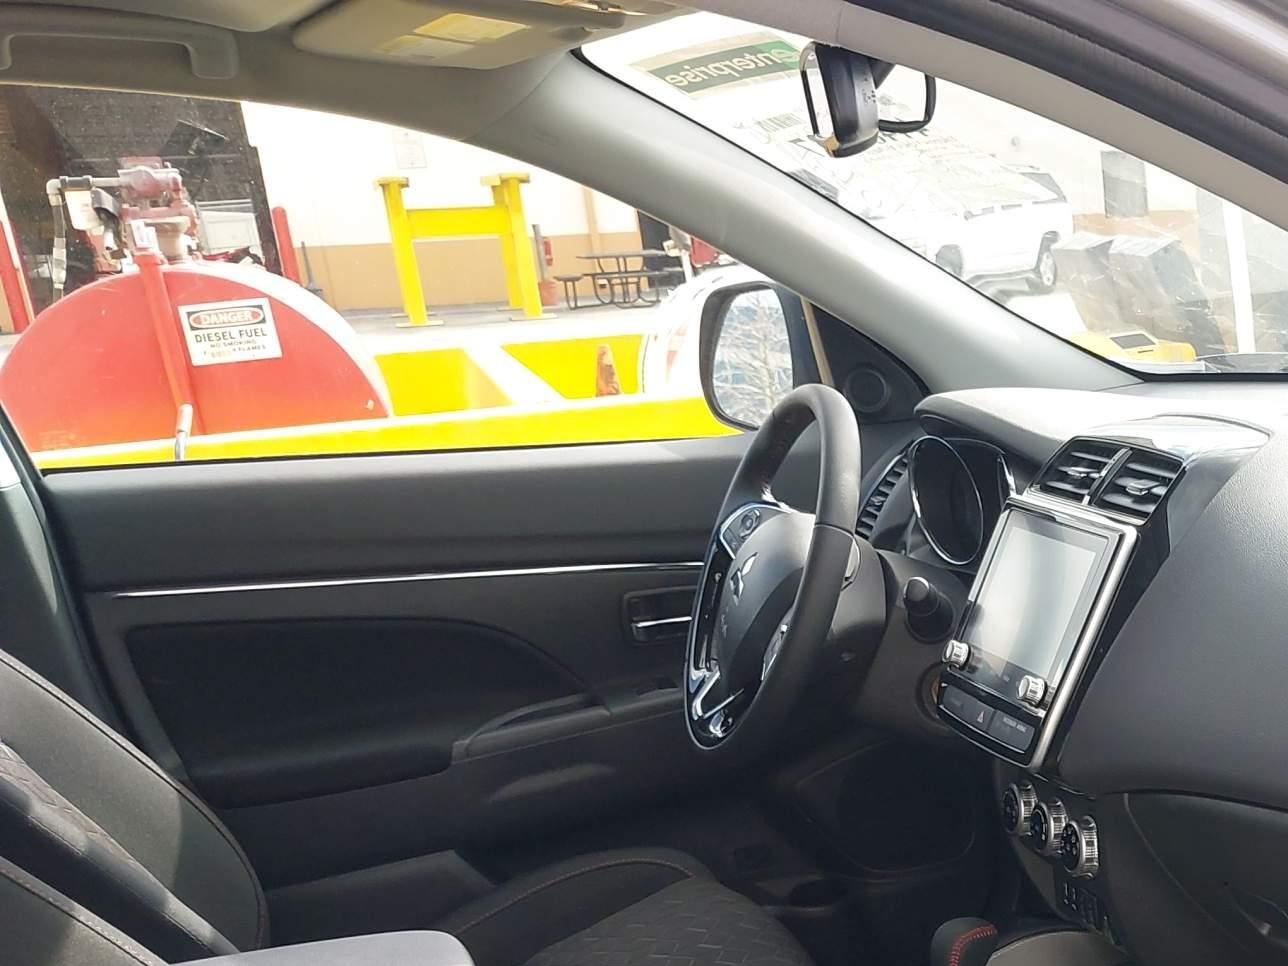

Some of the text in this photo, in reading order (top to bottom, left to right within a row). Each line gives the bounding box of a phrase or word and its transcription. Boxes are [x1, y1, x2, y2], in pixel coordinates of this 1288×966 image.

[200, 309, 252, 325] DANGER
[194, 327, 268, 344] DIESEL FUEL
[223, 338, 257, 348] SMOKING
